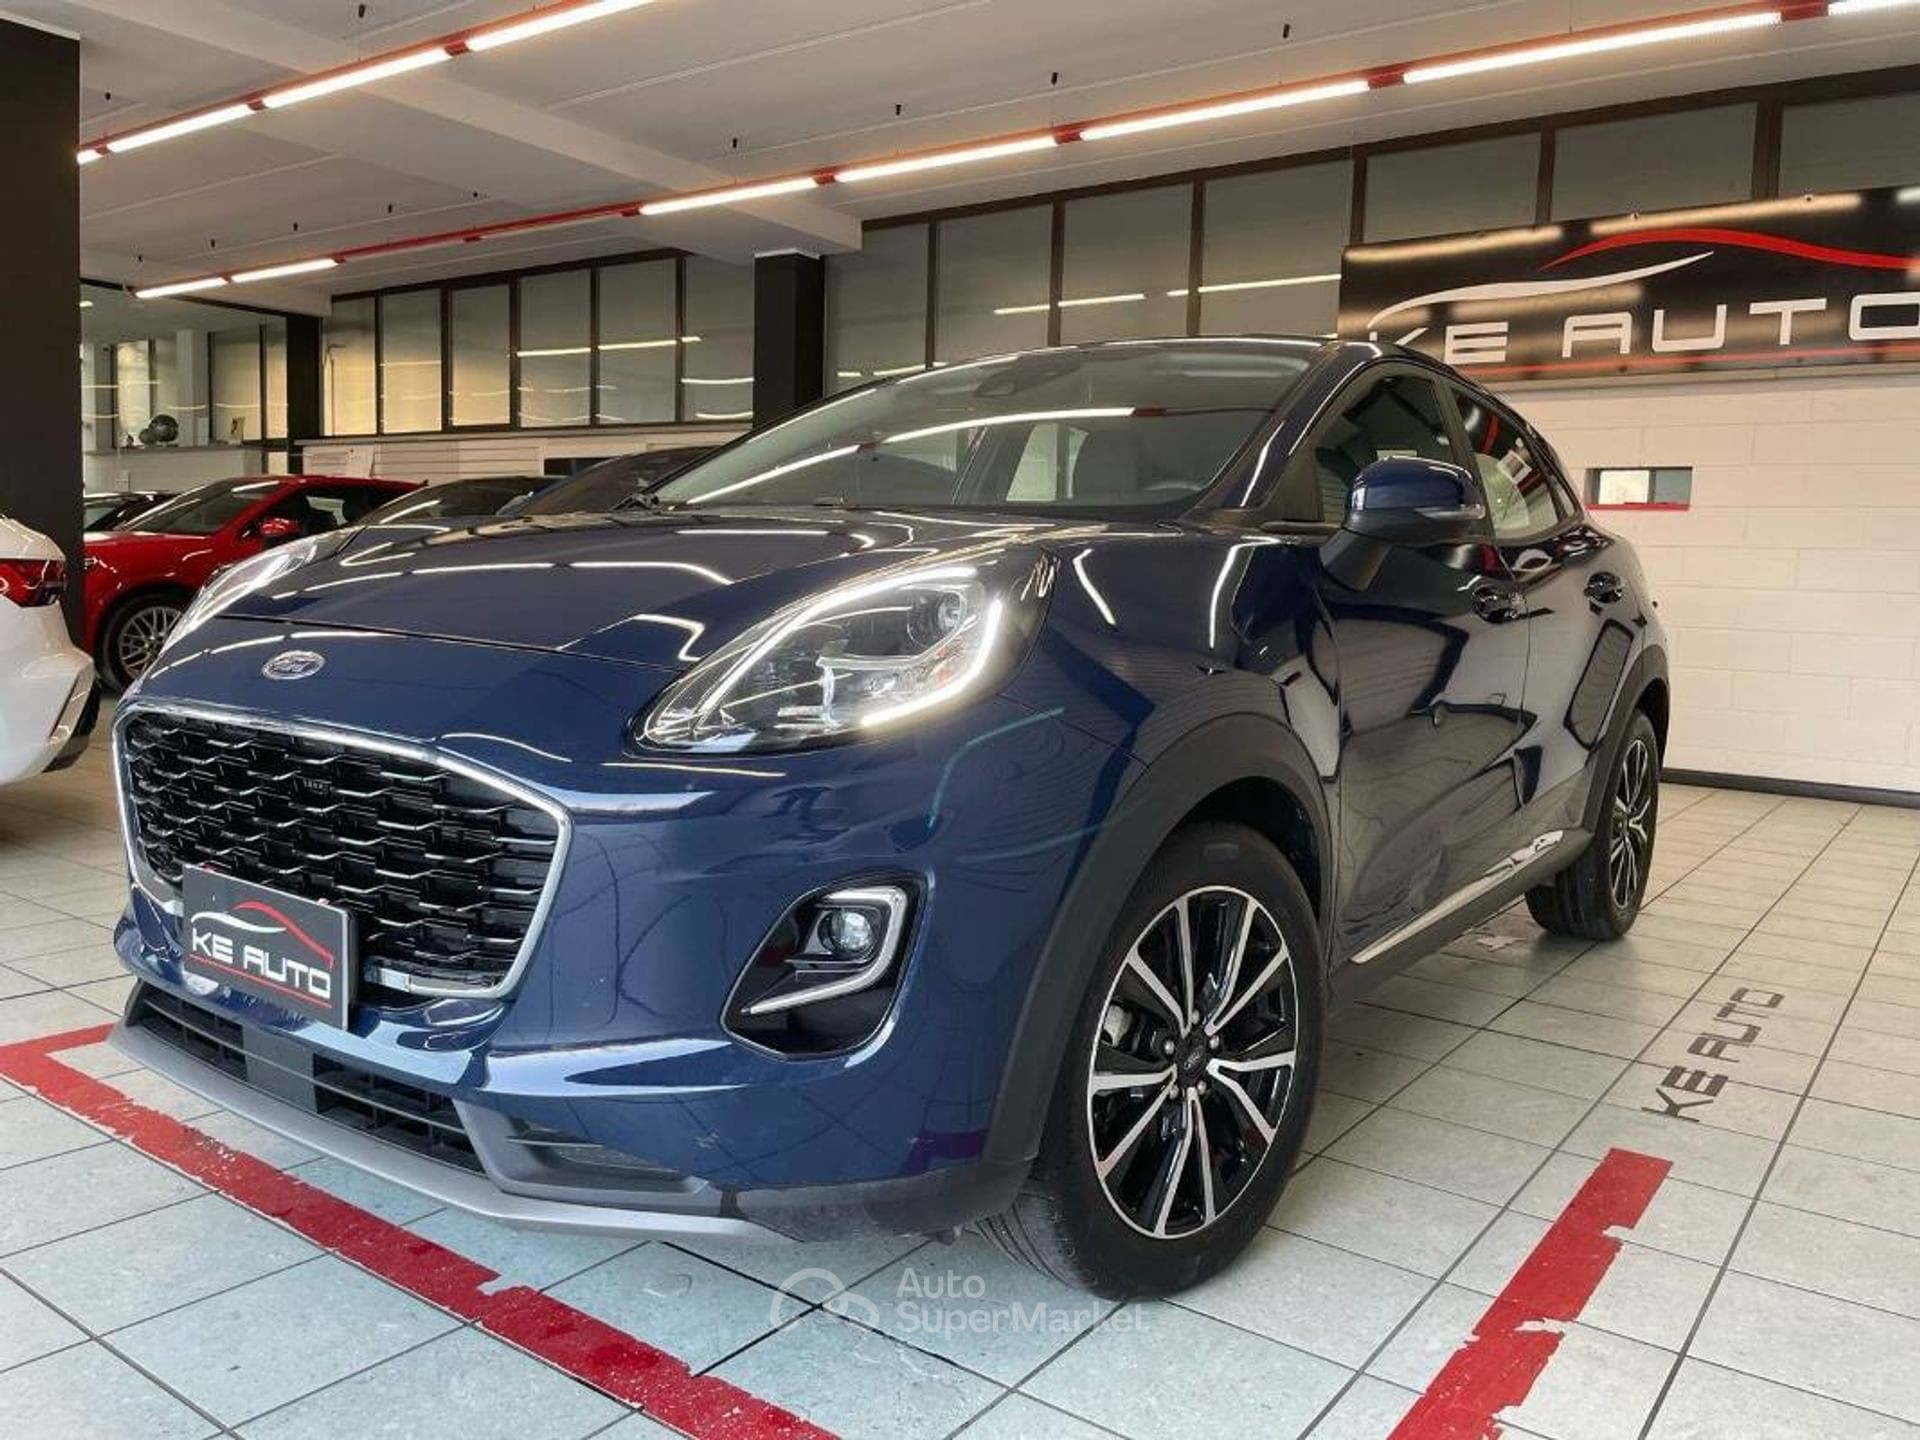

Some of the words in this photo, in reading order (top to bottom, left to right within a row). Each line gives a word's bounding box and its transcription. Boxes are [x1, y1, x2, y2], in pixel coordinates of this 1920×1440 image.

[1562, 292, 1920, 358] AUTO
[192, 927, 233, 964] KE
[243, 945, 331, 1000] AUTO
[1641, 1065, 1729, 1122] KE
[1687, 987, 1785, 1063] AUTO
